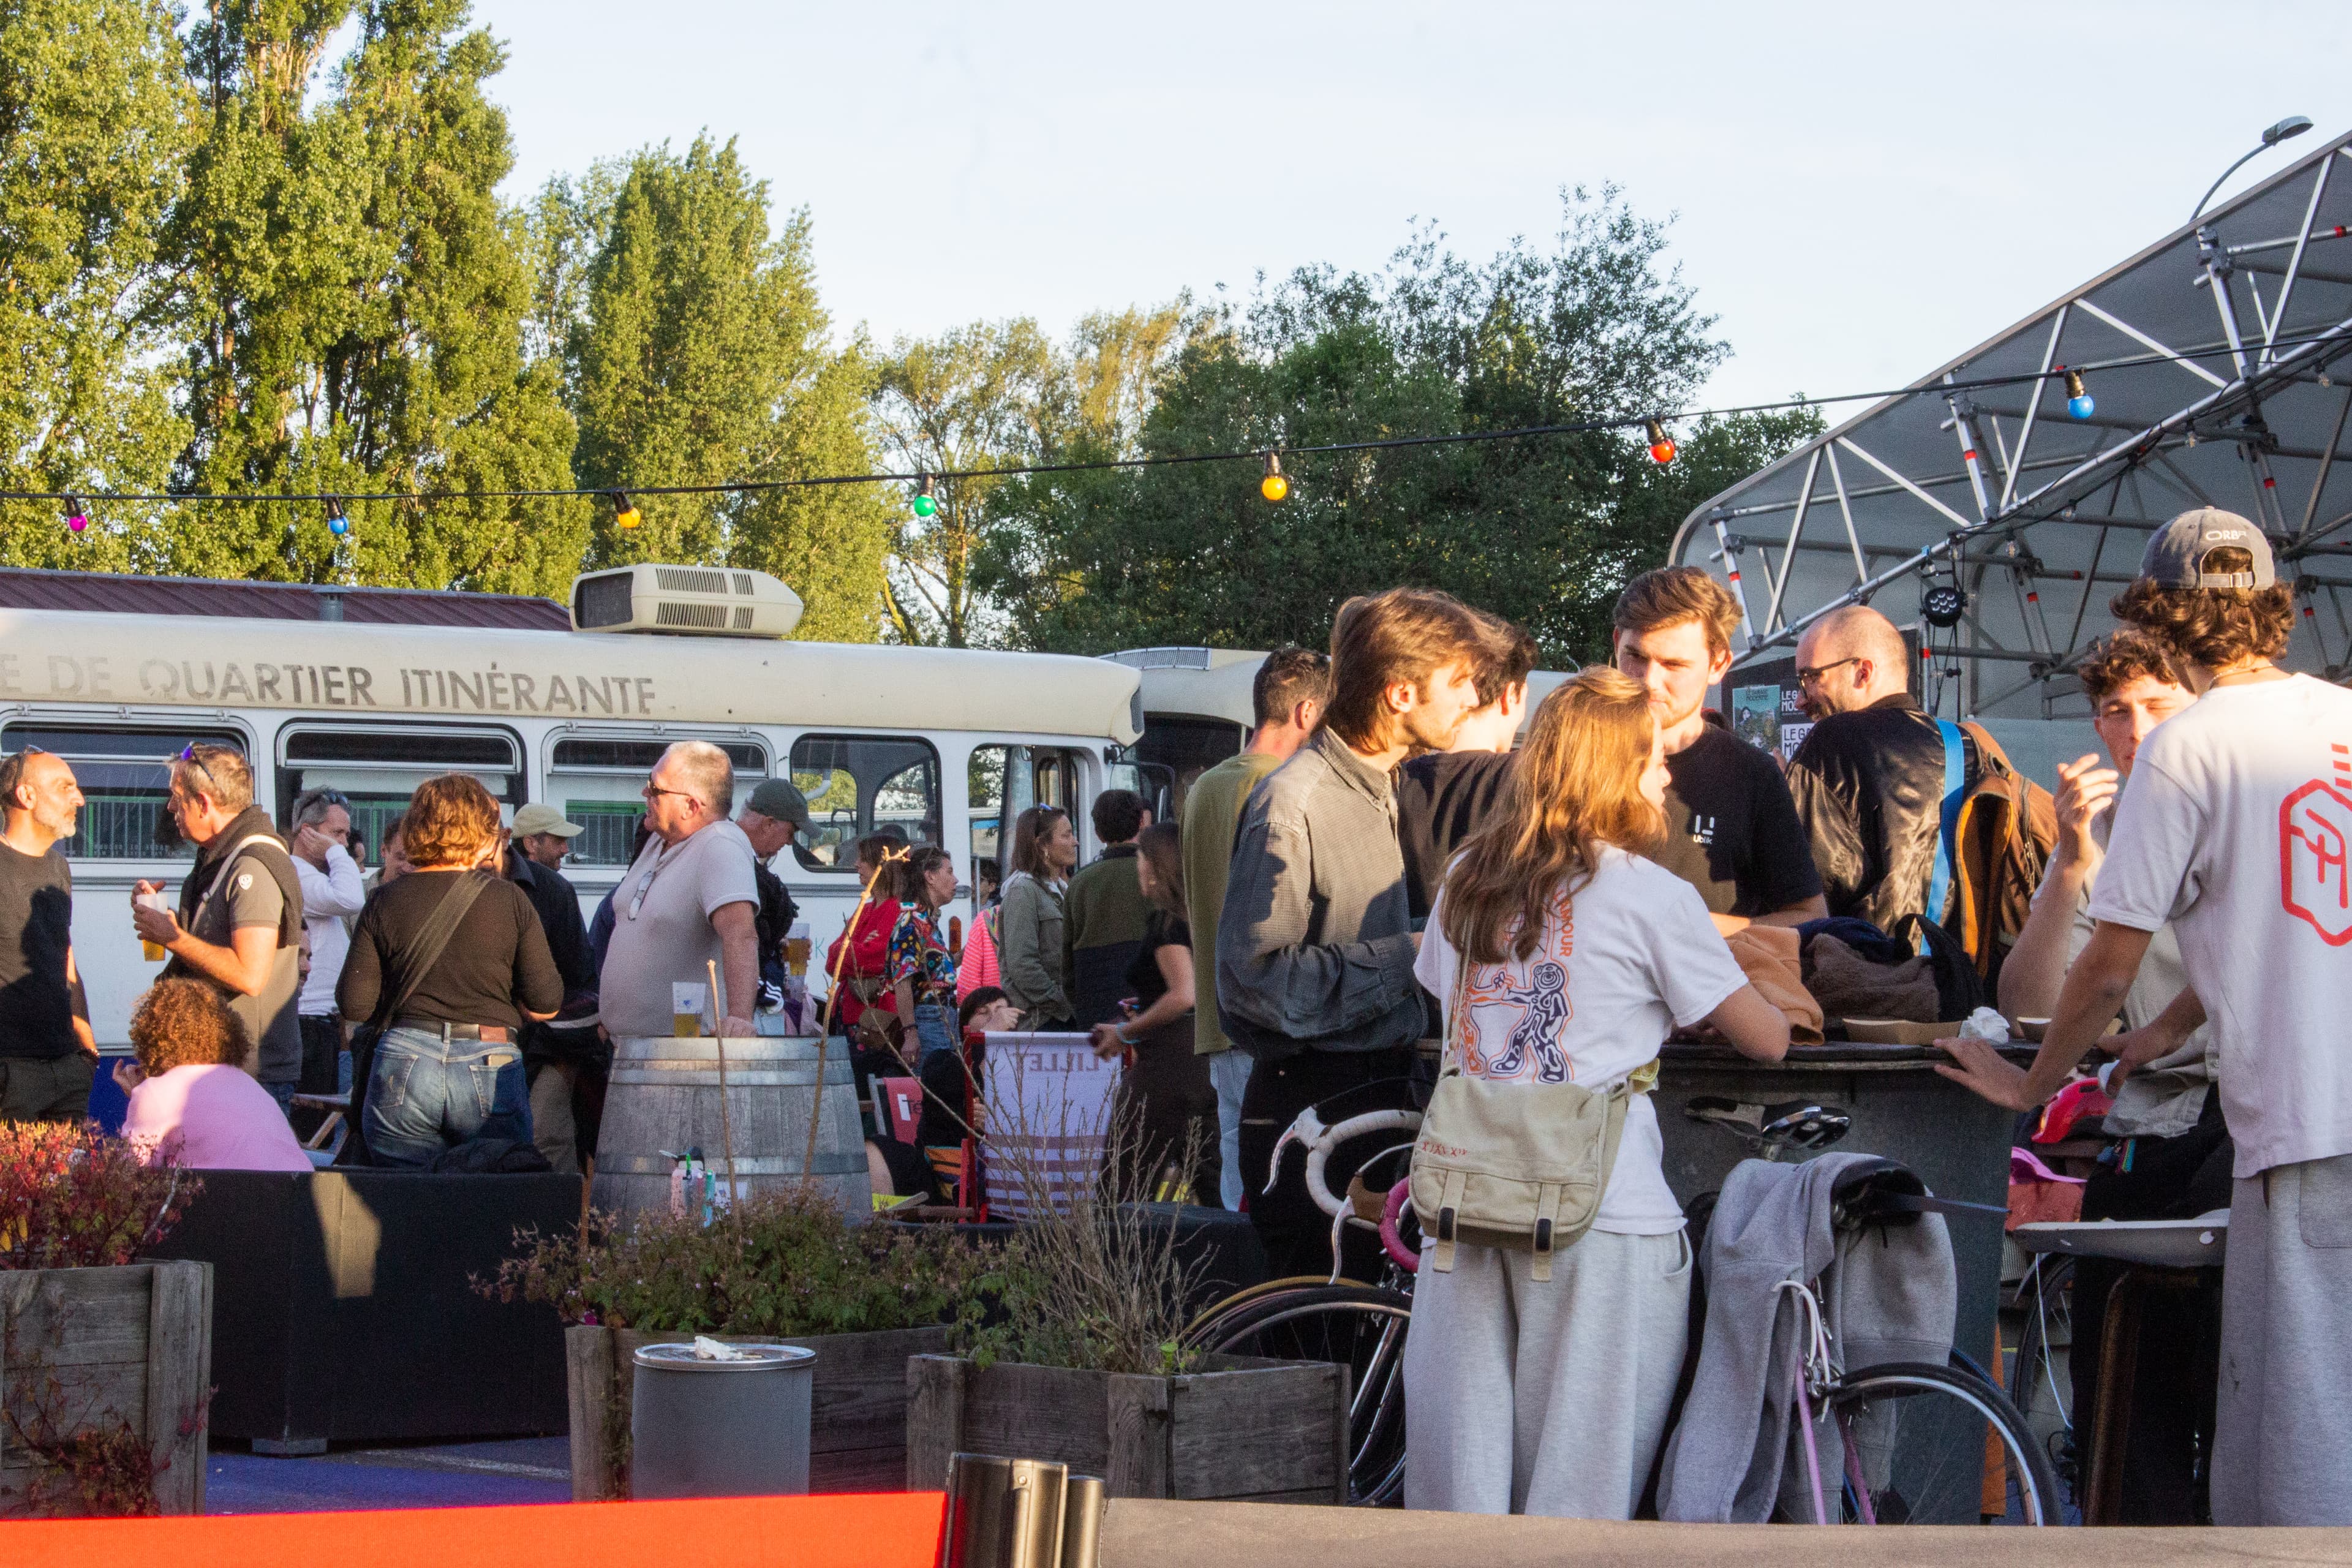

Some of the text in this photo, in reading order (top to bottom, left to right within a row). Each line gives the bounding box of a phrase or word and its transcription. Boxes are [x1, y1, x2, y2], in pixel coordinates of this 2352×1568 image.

[48, 655, 113, 696] DE
[139, 658, 377, 707] QUARTIER
[400, 662, 656, 714] ITINÉRANTE
